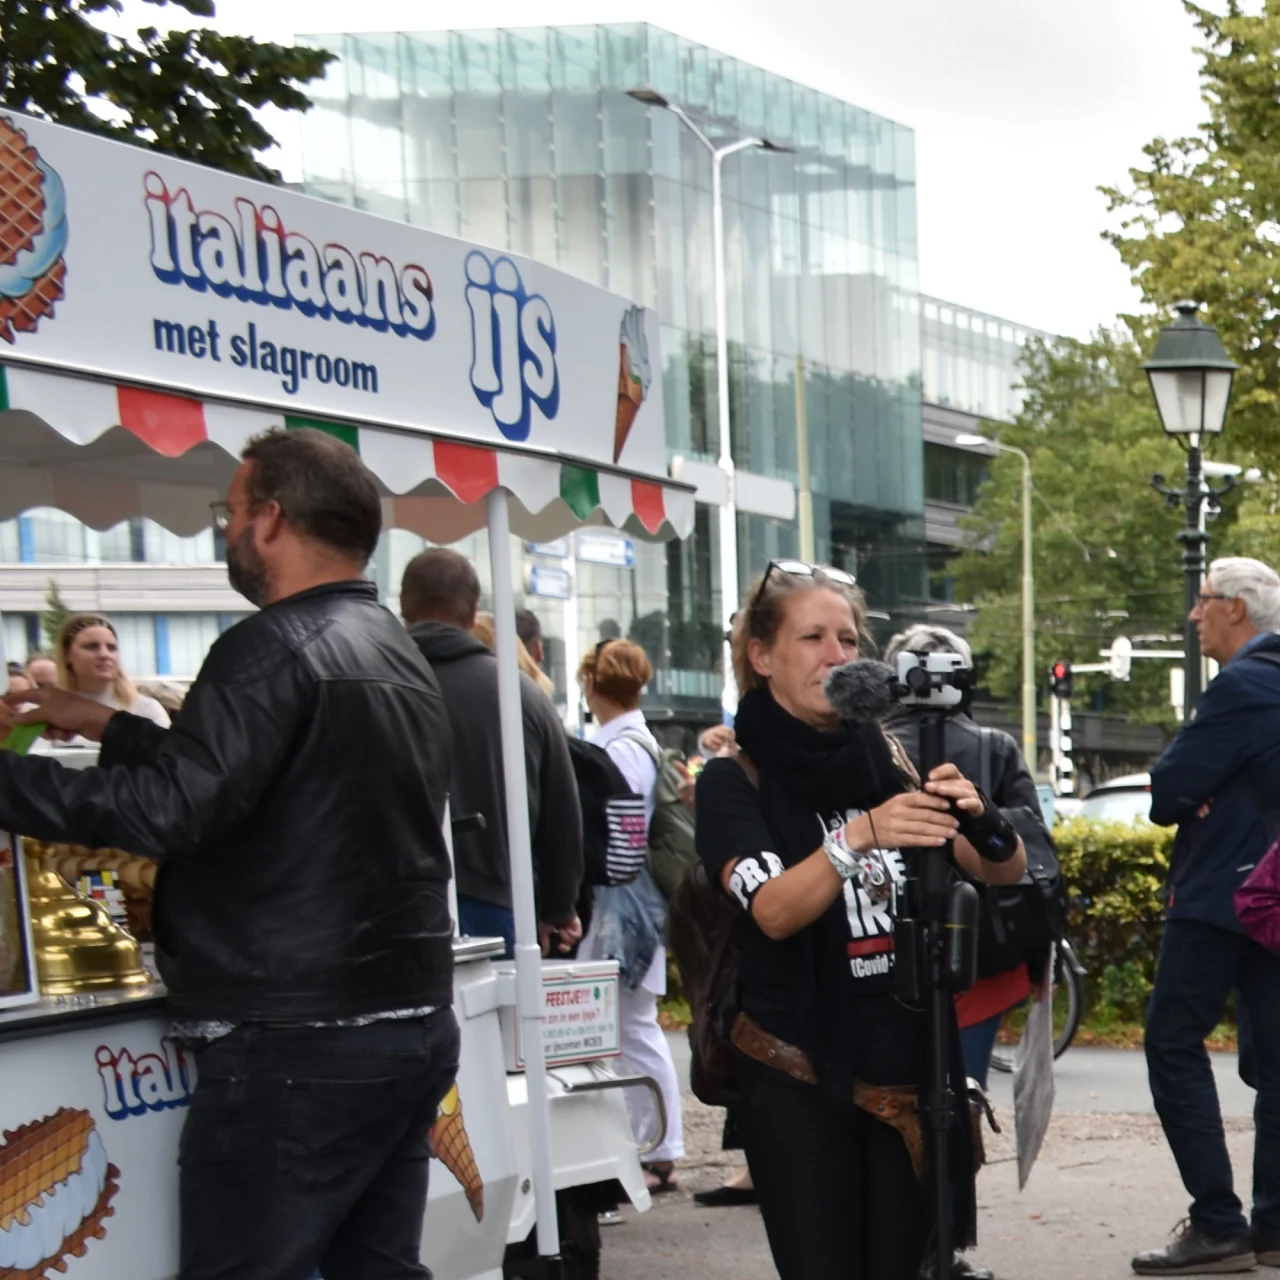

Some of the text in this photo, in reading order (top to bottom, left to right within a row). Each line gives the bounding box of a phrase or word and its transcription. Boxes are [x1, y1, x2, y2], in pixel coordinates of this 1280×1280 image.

[144, 170, 560, 442] italiaans ijs
[153, 318, 380, 395] met slagroom
